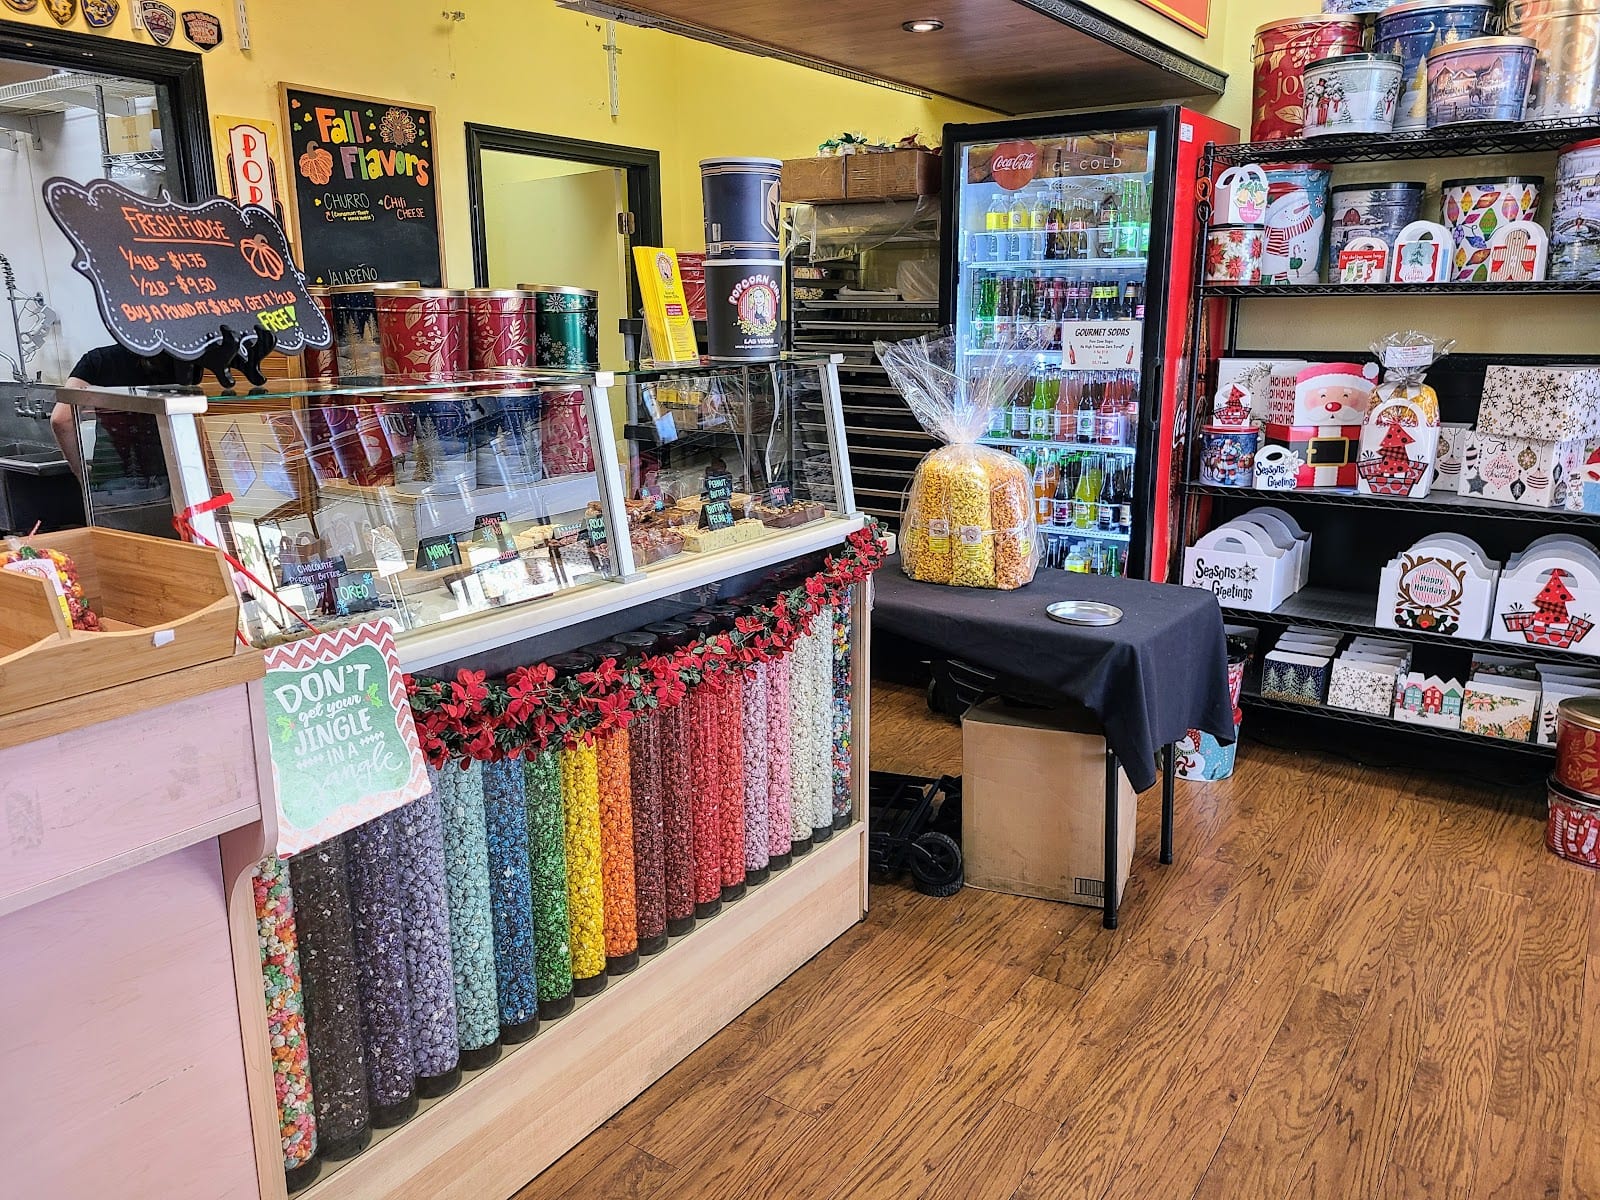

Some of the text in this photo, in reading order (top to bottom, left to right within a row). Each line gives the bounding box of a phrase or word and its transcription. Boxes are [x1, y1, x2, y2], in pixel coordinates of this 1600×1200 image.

[315, 107, 364, 144] Fall
[340, 146, 429, 186] Flavors
[1046, 157, 1123, 173] ICE COLD
[324, 192, 370, 210] CHURRO
[121, 207, 230, 240] FRESH FUDGE
[397, 207, 425, 220] CHEESE
[167, 251, 207, 271] $4.75
[176, 274, 217, 295] $9.50
[728, 274, 781, 305] POPCORN GIRL
[161, 302, 200, 320] POUND
[197, 301, 210, 315] AT
[248, 295, 264, 313] GET
[257, 305, 300, 332] FREE!
[1075, 328, 1131, 337] GOURMET SODAS
[1491, 462, 1512, 471] Merry
[1267, 475, 1296, 489] Greetings
[706, 502, 727, 514] BUTTER
[289, 570, 341, 585] PEANUT BUTTER
[297, 560, 333, 574] CHOCOLATE
[1195, 558, 1236, 580] Seasons
[1414, 583, 1447, 595] Holidays
[1420, 574, 1444, 585] Happy
[340, 584, 369, 600] OREO
[1212, 580, 1253, 601] Greetings
[273, 663, 372, 714] DON'T
[298, 695, 362, 728] get your
[294, 707, 374, 757] JINGLE
[327, 741, 359, 766] IN A
[315, 741, 404, 795] angle
